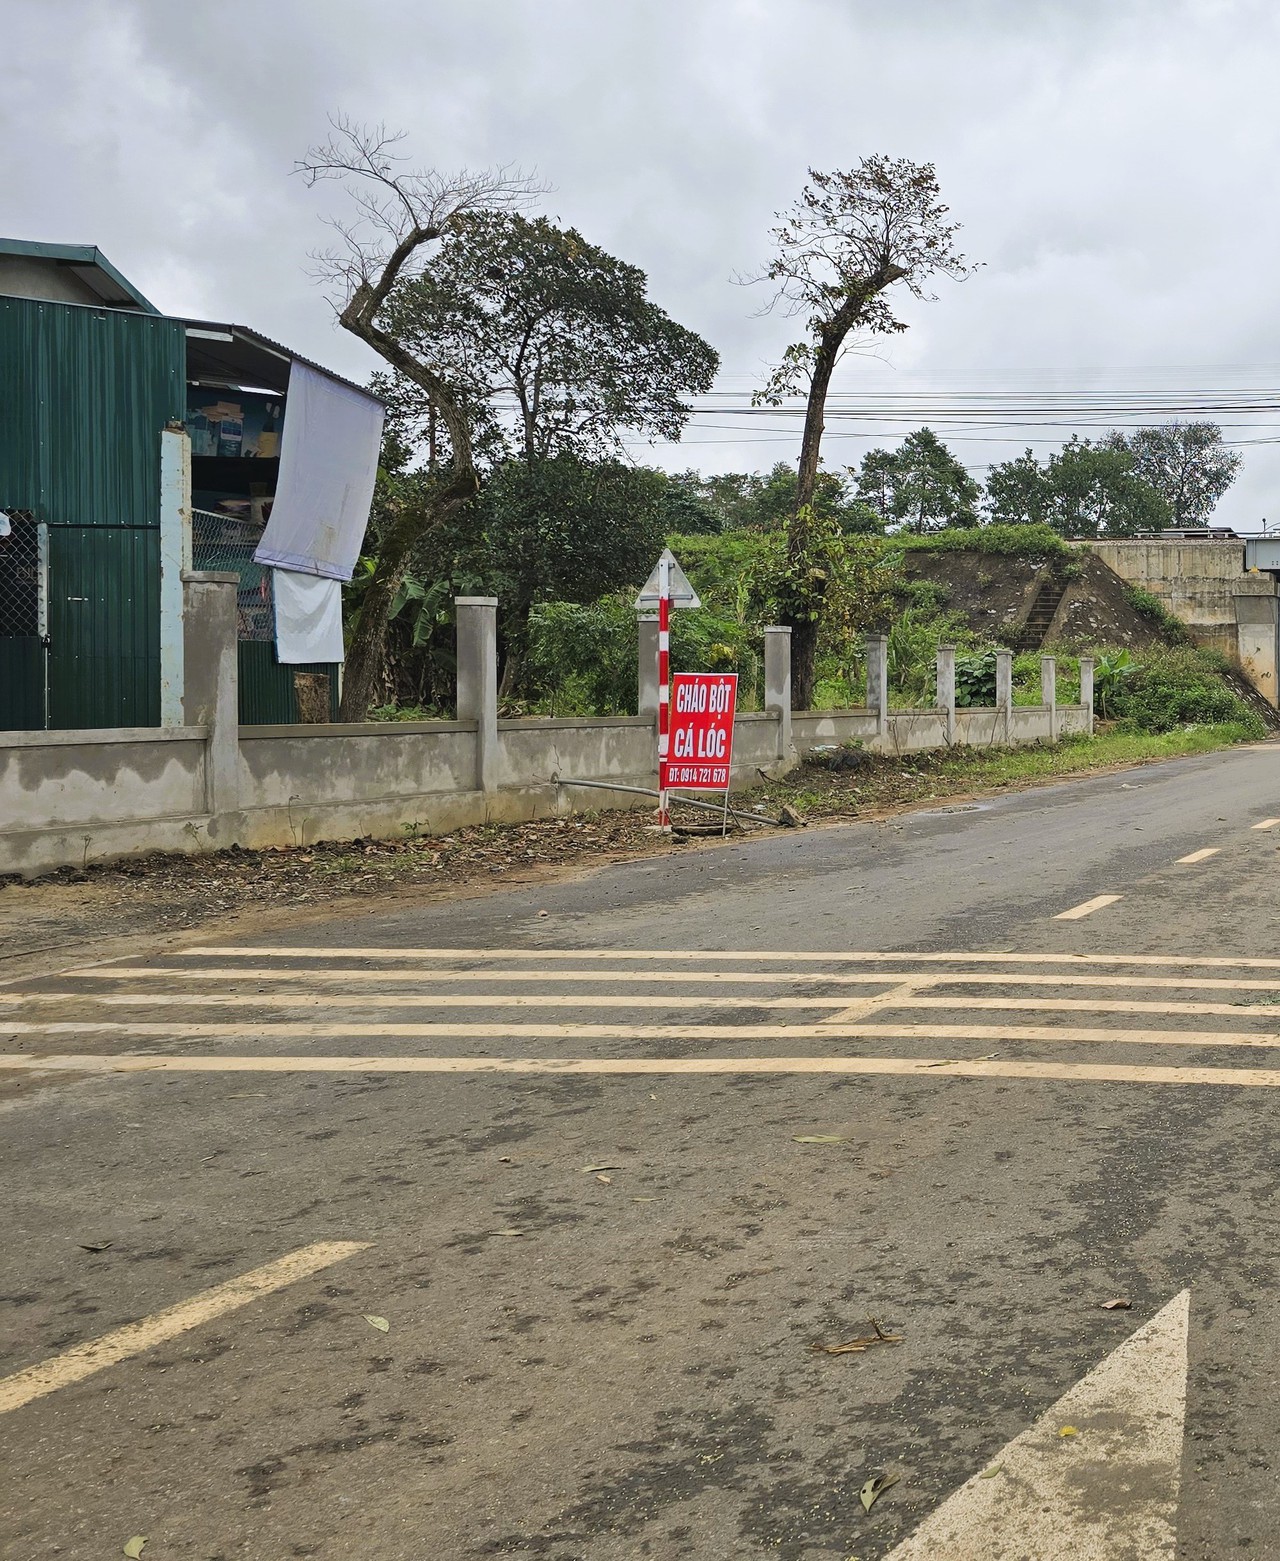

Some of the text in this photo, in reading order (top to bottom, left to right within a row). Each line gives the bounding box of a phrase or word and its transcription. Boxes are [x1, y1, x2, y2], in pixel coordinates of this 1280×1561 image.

[676, 678, 732, 720] CHÁO BỘT
[674, 722, 727, 759] CÁ LÓC
[680, 768, 697, 783] 0914
[699, 768, 711, 783] 721
[713, 768, 726, 783] 678
